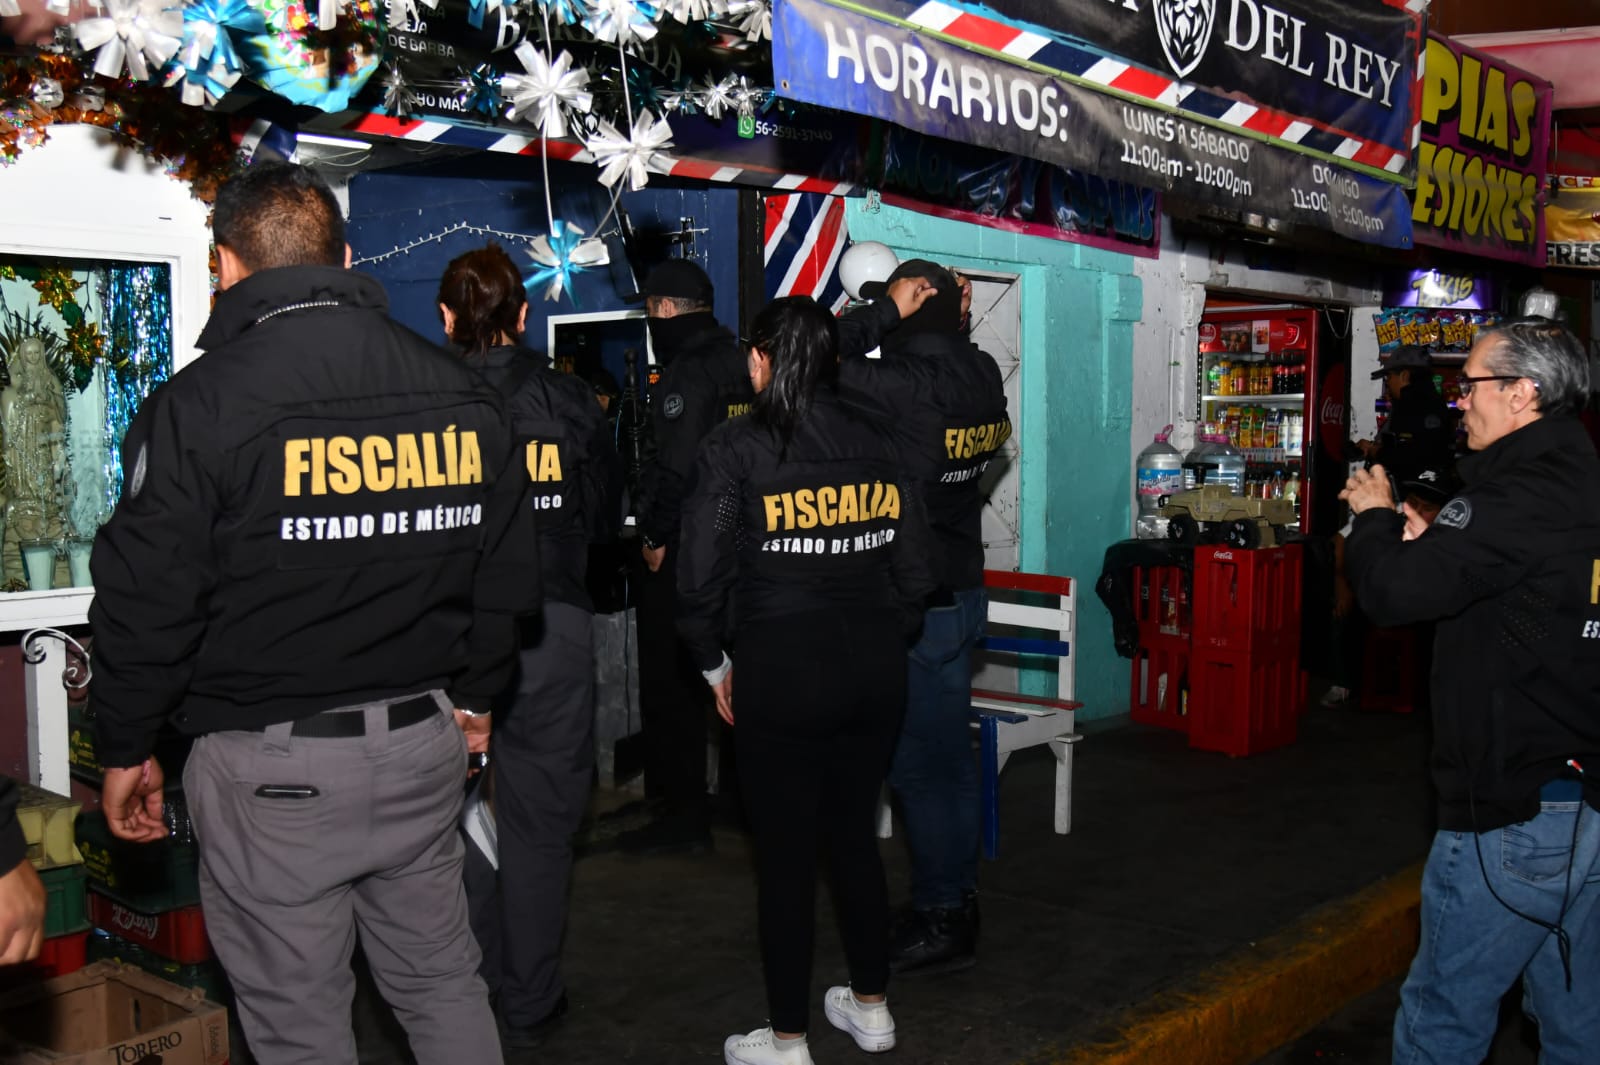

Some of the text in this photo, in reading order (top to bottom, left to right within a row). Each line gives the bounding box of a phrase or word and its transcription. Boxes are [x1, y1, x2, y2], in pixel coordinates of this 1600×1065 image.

[388, 34, 456, 58] DE BARBA
[1223, 0, 1401, 108] DEL REY
[823, 20, 1069, 142] HORARIOS:
[1123, 106, 1250, 164] LUNES A SÁBADO
[1120, 139, 1184, 178] 11:00am
[1195, 161, 1253, 198] 10:00pm
[1412, 273, 1474, 308] TKIS
[284, 424, 483, 497] FISCALÍA
[281, 503, 483, 541] ESTADO DE MÉXICO
[763, 480, 900, 532] FISCALÍA
[762, 528, 896, 555] ESTADO DE MÉXICO
[107, 1031, 183, 1065] TORERO
